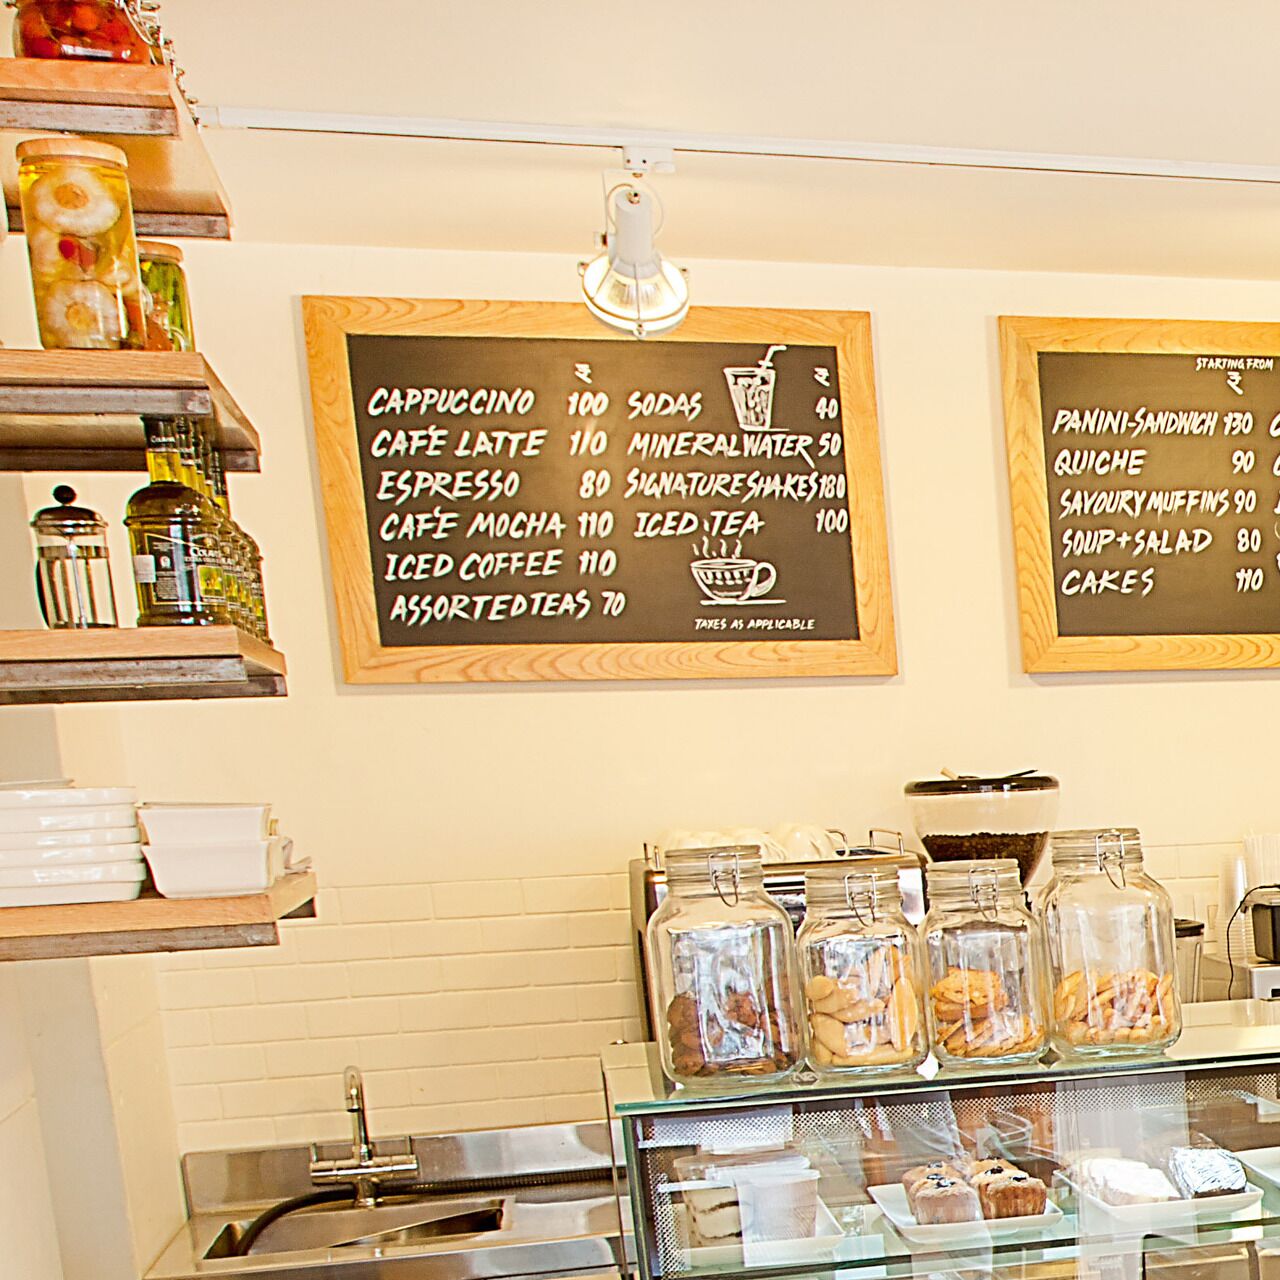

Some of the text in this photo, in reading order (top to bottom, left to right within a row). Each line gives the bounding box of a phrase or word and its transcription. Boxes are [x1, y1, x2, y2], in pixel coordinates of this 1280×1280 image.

[1196, 357, 1273, 371] STARTING FROM
[367, 386, 609, 416] CAPPUCCINO 100
[627, 391, 839, 421] SODAS 40
[1052, 406, 1254, 439] PANINI-SANDWICH 130
[454, 429, 548, 459] LATTE
[569, 430, 608, 456] 110
[627, 432, 842, 469] MINERAL WATER 50
[1054, 448, 1255, 476] QUICHE 90
[376, 469, 611, 506] ESPRESSO 80
[624, 467, 846, 503] SIGNATURE SHAKES 180
[1059, 488, 1257, 521] SAVOURY MUFFINS 90
[466, 510, 567, 540] MOCHA
[578, 510, 614, 539] 110
[633, 508, 848, 538] ICED TEA 100
[1236, 527, 1262, 553] 80
[384, 549, 617, 581] ICED COFFEE 110
[1060, 567, 1264, 599] CAKES 110
[390, 588, 626, 627] ASSORTED TEAS 70
[694, 618, 815, 631] TAXES AS APPLICABLE
